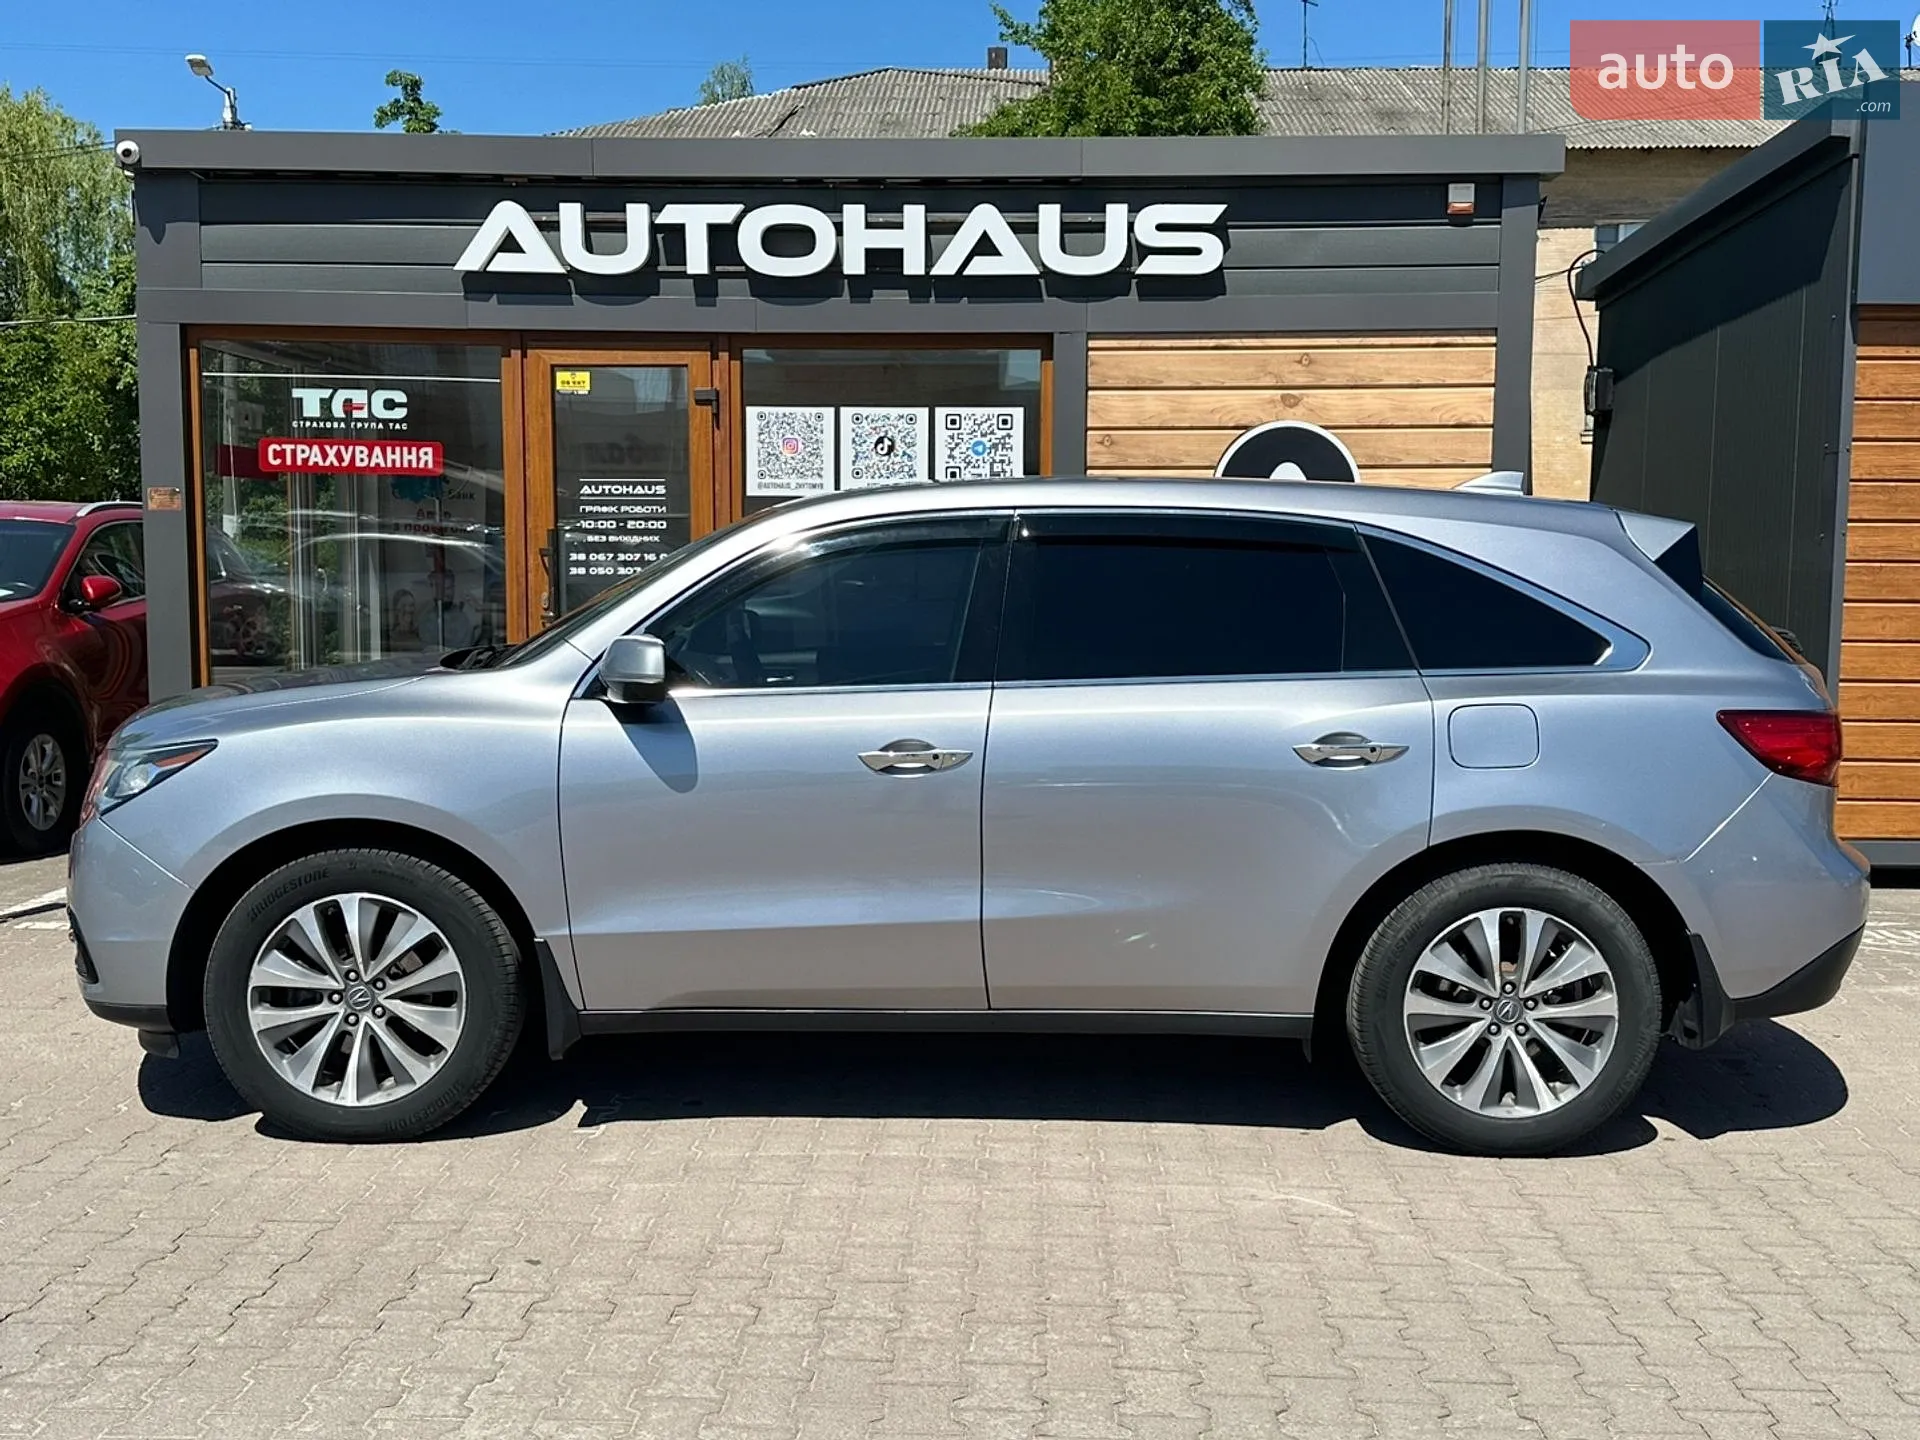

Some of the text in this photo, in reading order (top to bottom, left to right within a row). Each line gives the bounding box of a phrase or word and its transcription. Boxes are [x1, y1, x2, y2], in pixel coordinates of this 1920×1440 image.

[453, 200, 1228, 277] AUTOHAUS
[291, 420, 408, 431] СТРАХОВА ГРУПА ТАС
[267, 443, 434, 469] СТРАХУВАННЯ
[579, 485, 667, 495] AUTOHAUS
[579, 505, 667, 513] ГРАФІК РОБОТИ
[579, 520, 617, 529] 10:00
[626, 520, 667, 529] 20:00
[586, 535, 607, 543] БЕЗ
[569, 553, 587, 561] 38
[589, 553, 615, 561] 067
[617, 553, 642, 561] 307
[569, 567, 587, 575] 38
[589, 567, 614, 575] 050
